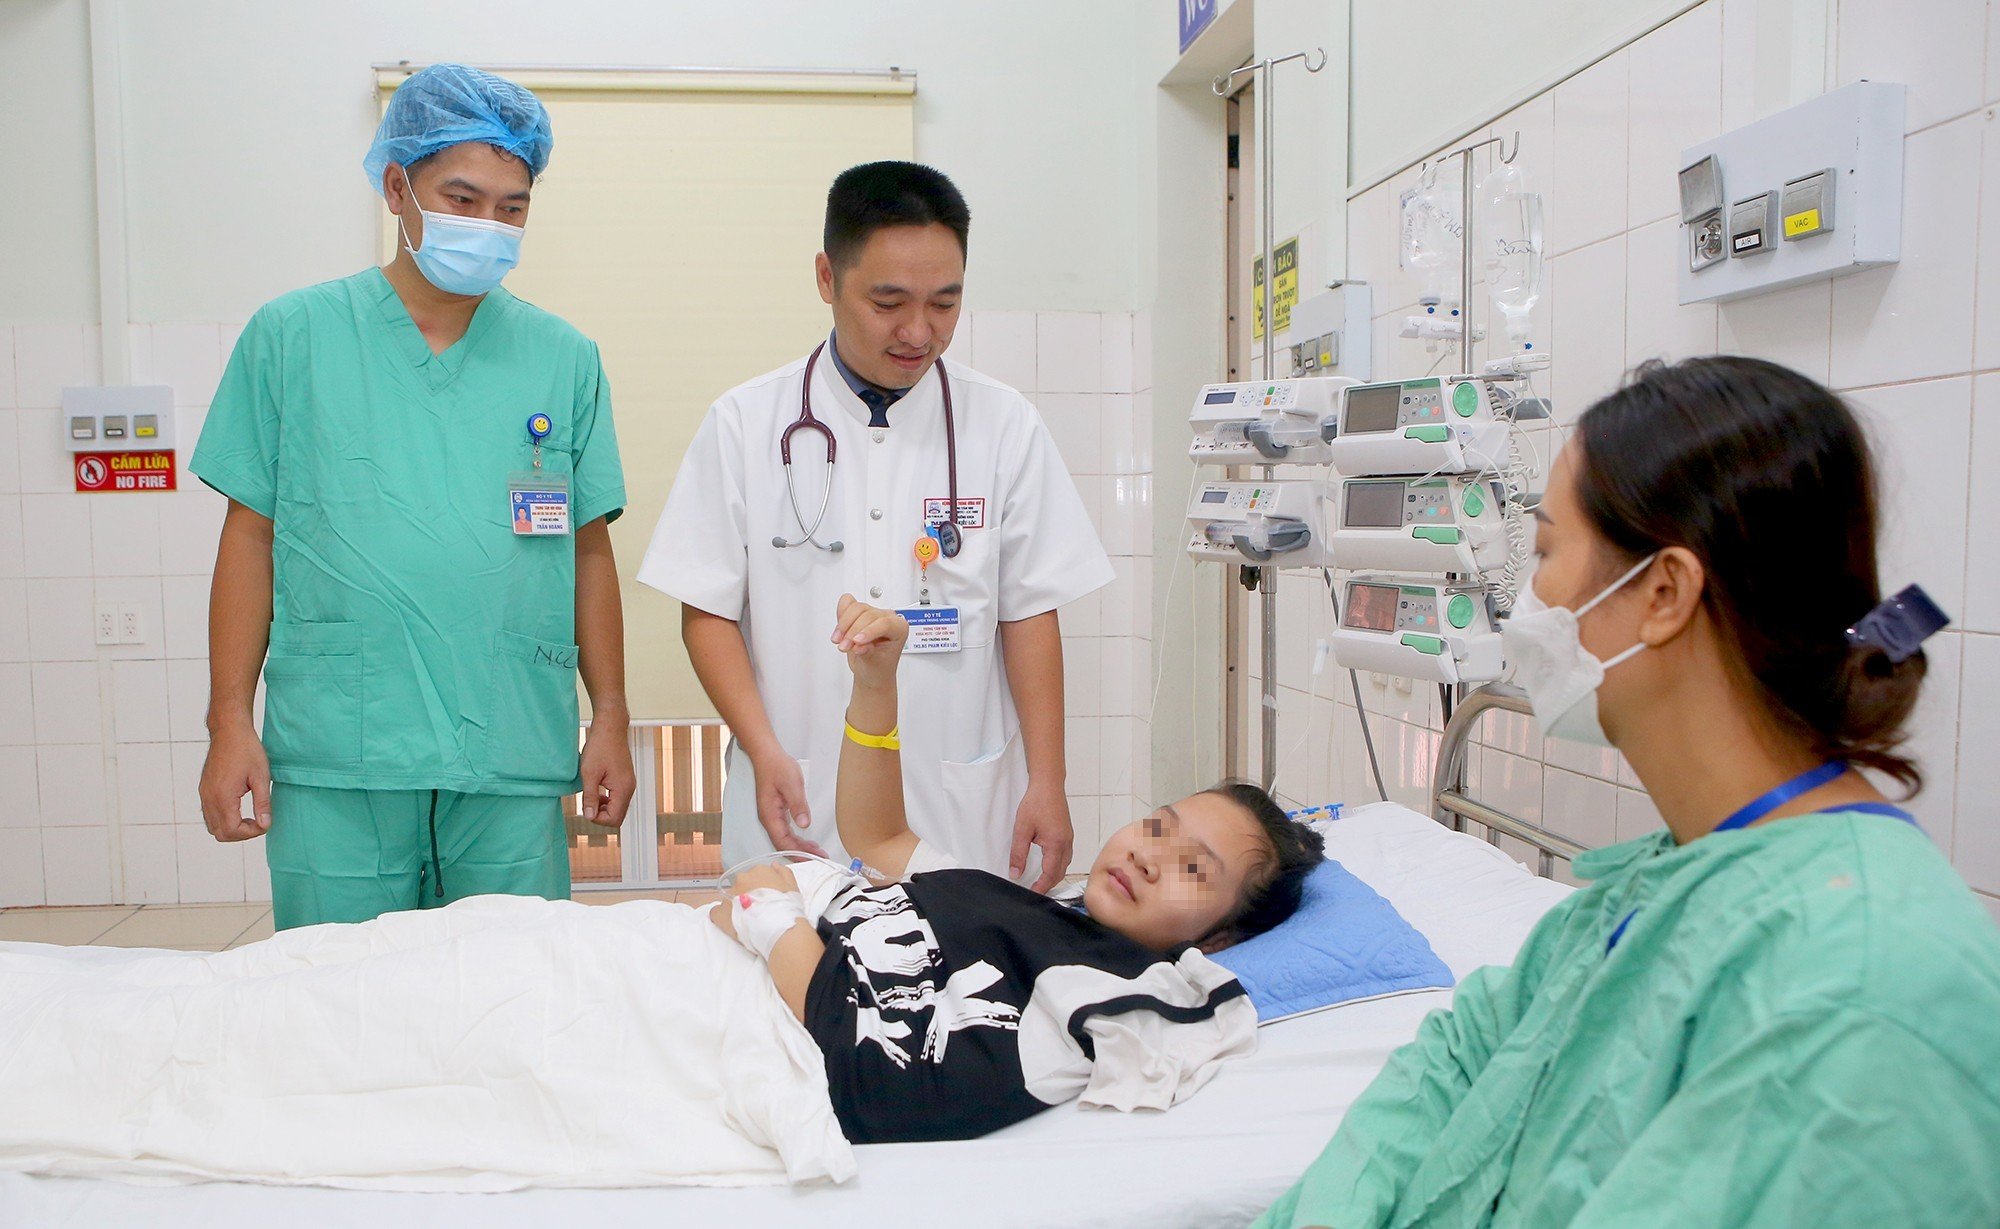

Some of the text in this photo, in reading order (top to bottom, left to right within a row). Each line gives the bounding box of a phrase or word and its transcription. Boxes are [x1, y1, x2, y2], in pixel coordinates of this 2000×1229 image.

[1794, 218, 1808, 228] VAC
[1741, 238, 1752, 246] AIR
[1278, 250, 1292, 271] BÁO
[111, 453, 170, 469] CẤM LỬA
[116, 475, 167, 488] NO FIRE
